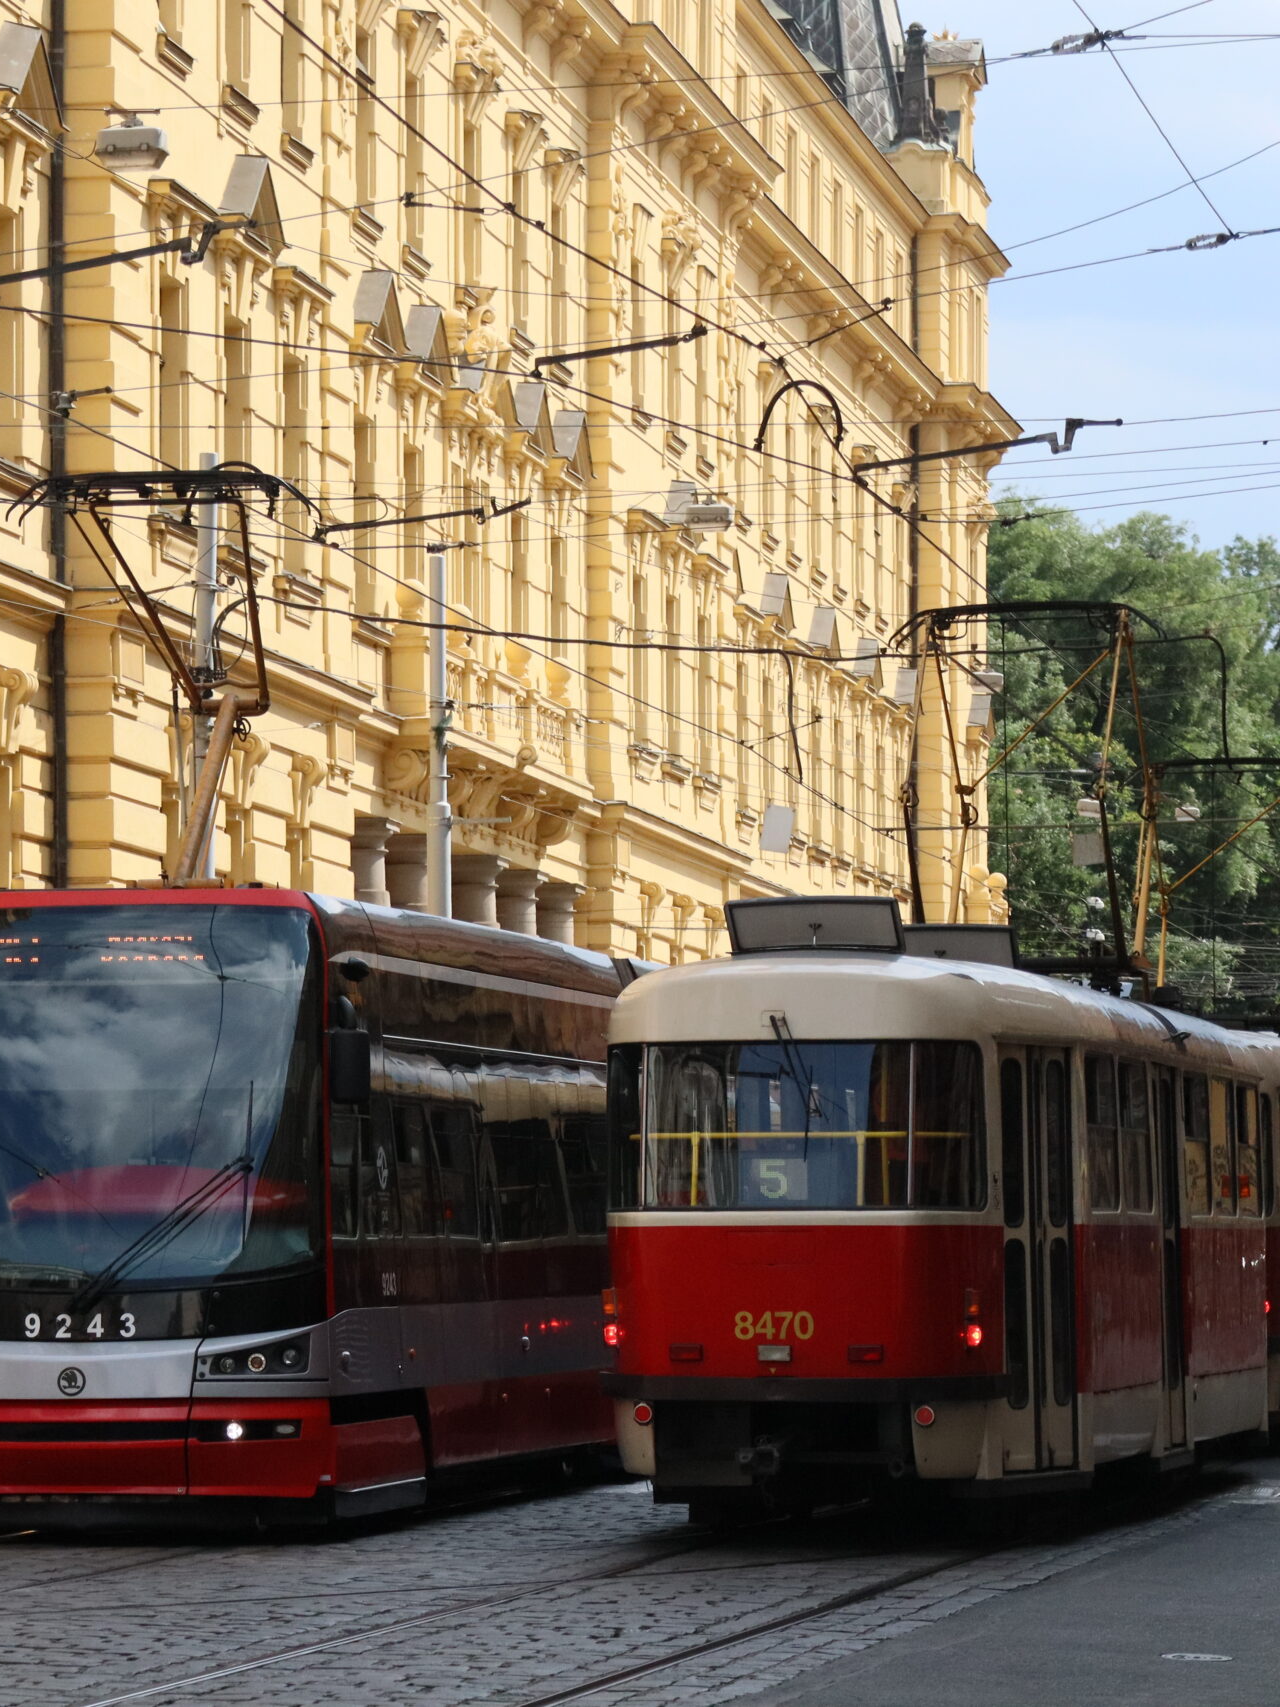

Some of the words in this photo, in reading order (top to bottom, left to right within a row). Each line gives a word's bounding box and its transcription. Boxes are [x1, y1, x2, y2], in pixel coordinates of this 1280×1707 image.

[760, 1159, 787, 1198] 5
[382, 1271, 397, 1296] 9243
[24, 1313, 136, 1339] 9243
[734, 1311, 814, 1340] 8470
